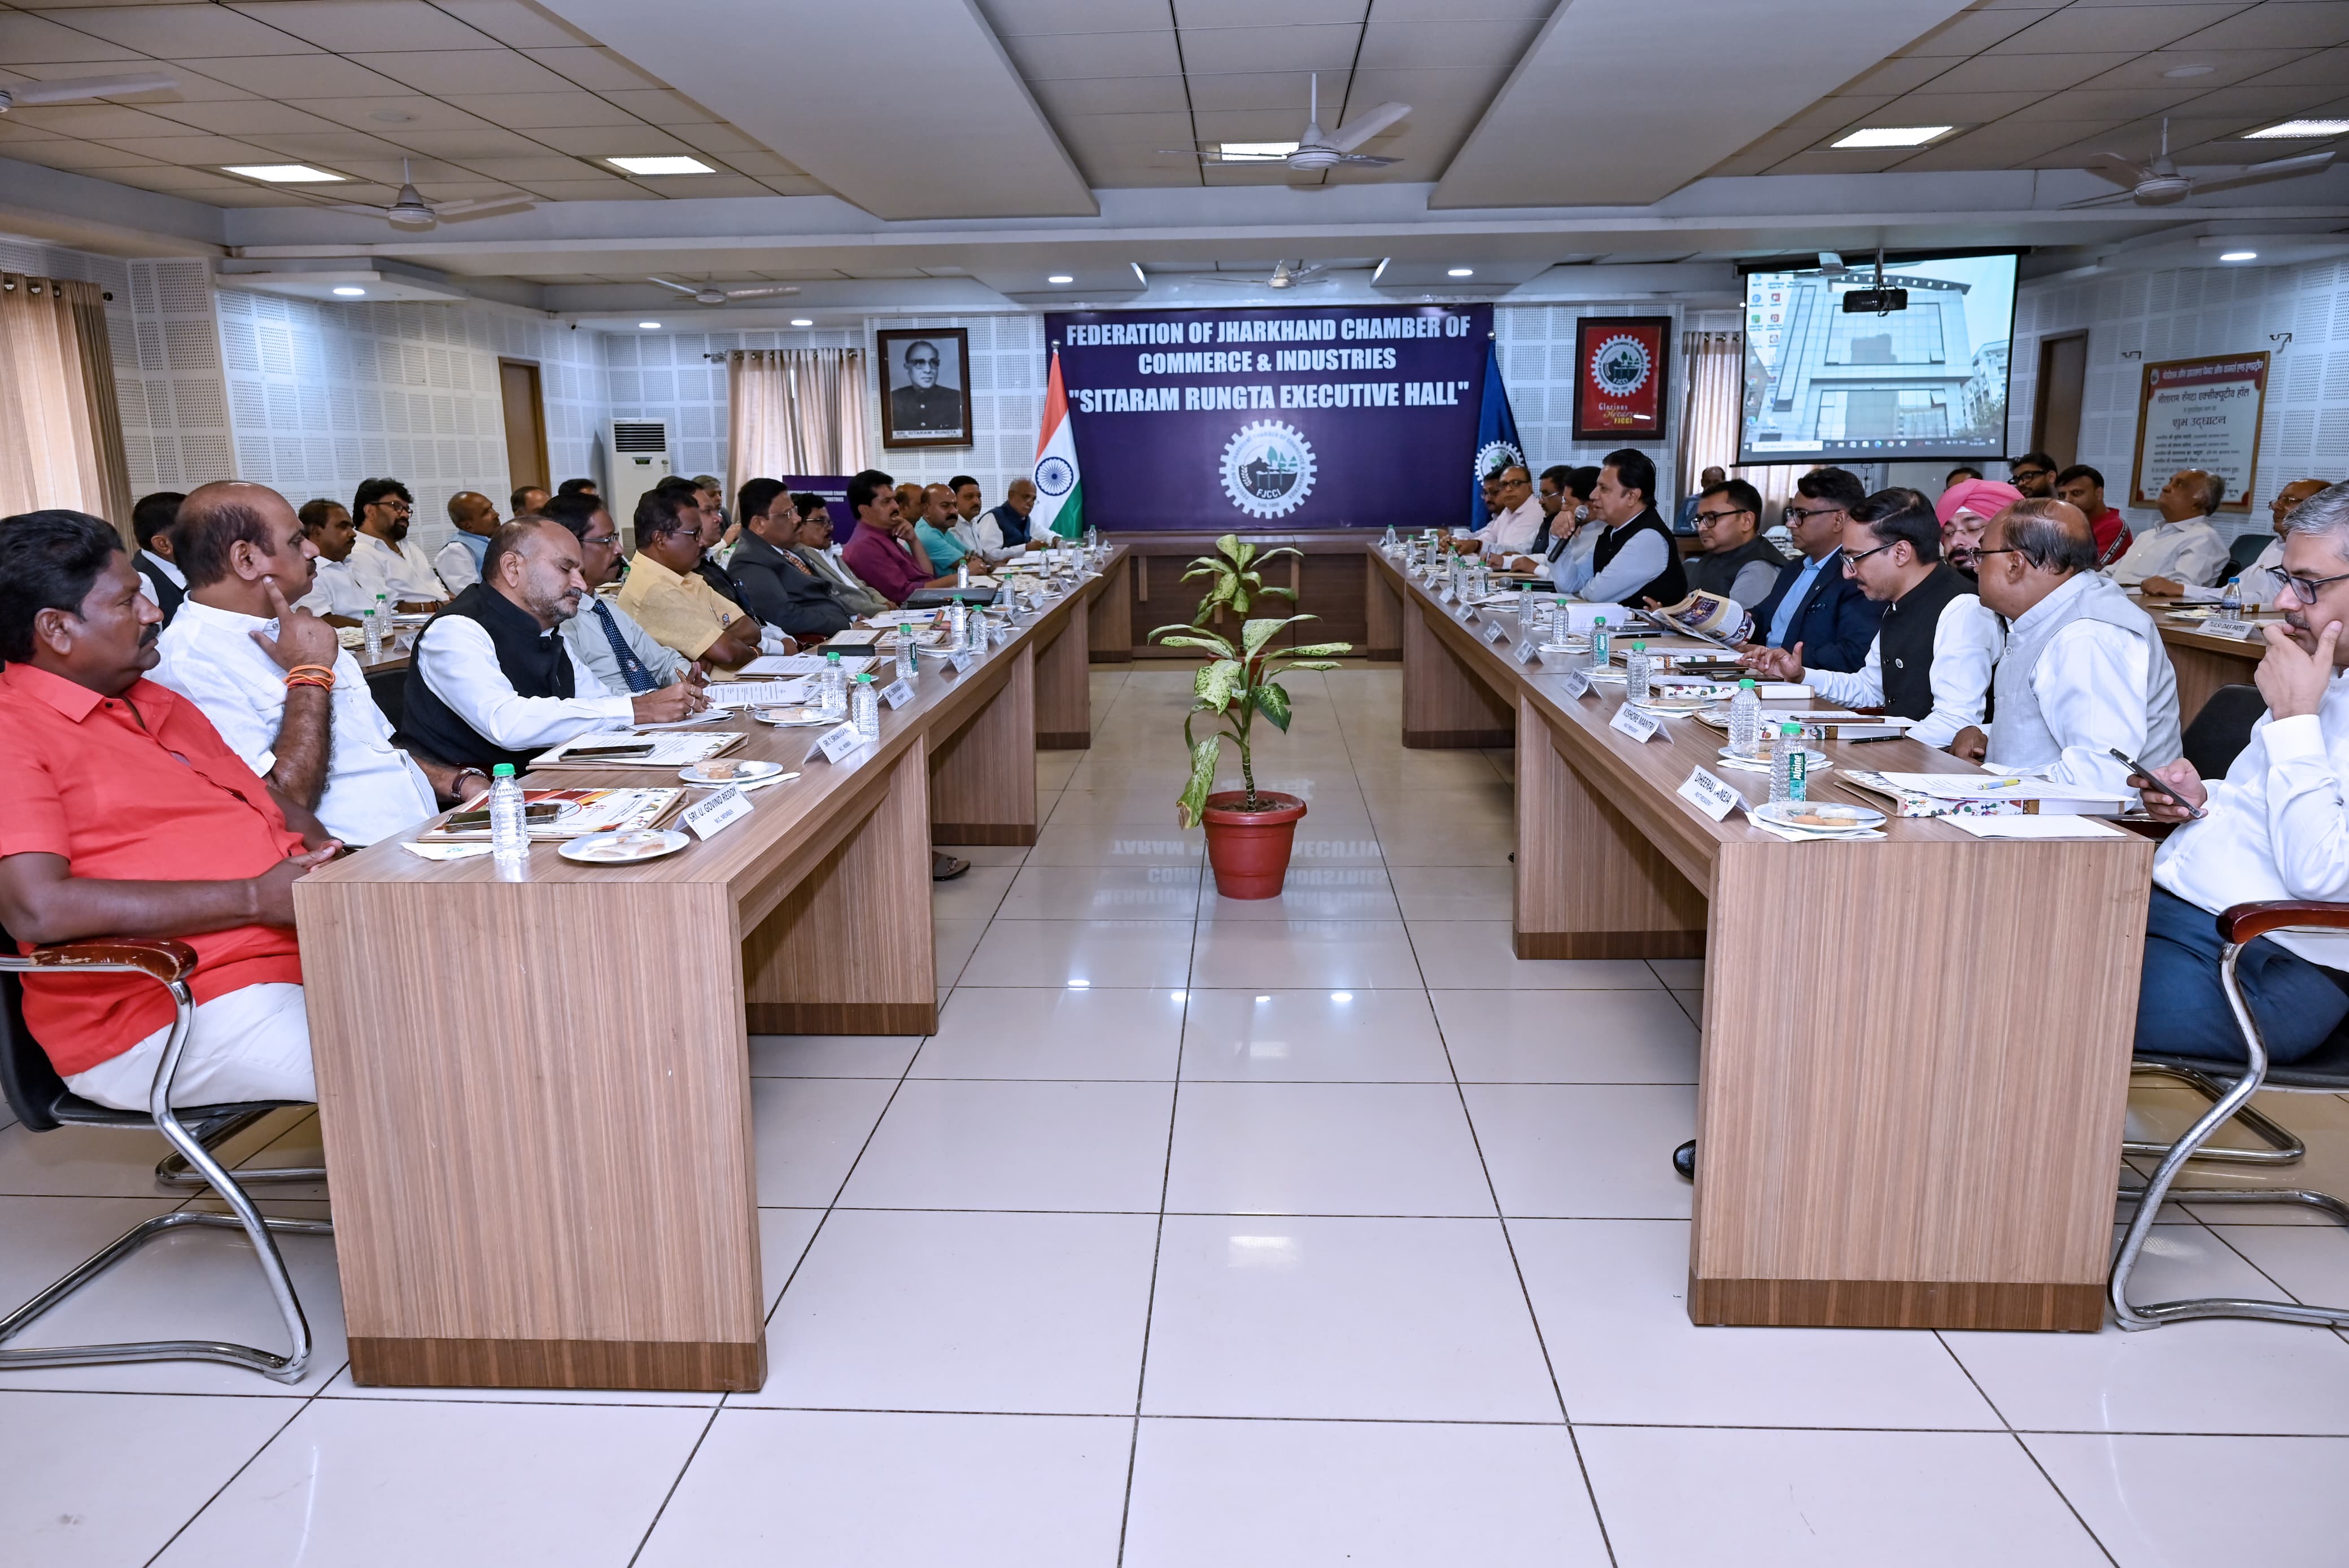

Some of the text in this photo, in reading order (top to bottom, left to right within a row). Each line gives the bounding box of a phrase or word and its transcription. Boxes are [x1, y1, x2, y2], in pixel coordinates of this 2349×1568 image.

[1067, 316, 1471, 346] FEDERATION OF JHARKHAND CHAMBER OF
[1138, 347, 1397, 375] COMMERCE & INDUSTRIES
[1068, 381, 1470, 413] "SITARAM RUNGTA EXECUTIVE HALL"
[2237, 385, 2250, 398] हॉल
[2173, 417, 2188, 430] शुभ
[1256, 488, 1281, 498] FJCCI
[1622, 707, 1656, 732] KISHORE MANTRI
[1793, 754, 1803, 780] Alpine
[1694, 772, 1717, 792] DHEERAJ
[688, 785, 737, 823] SRI. U. GOVIND REDDY
